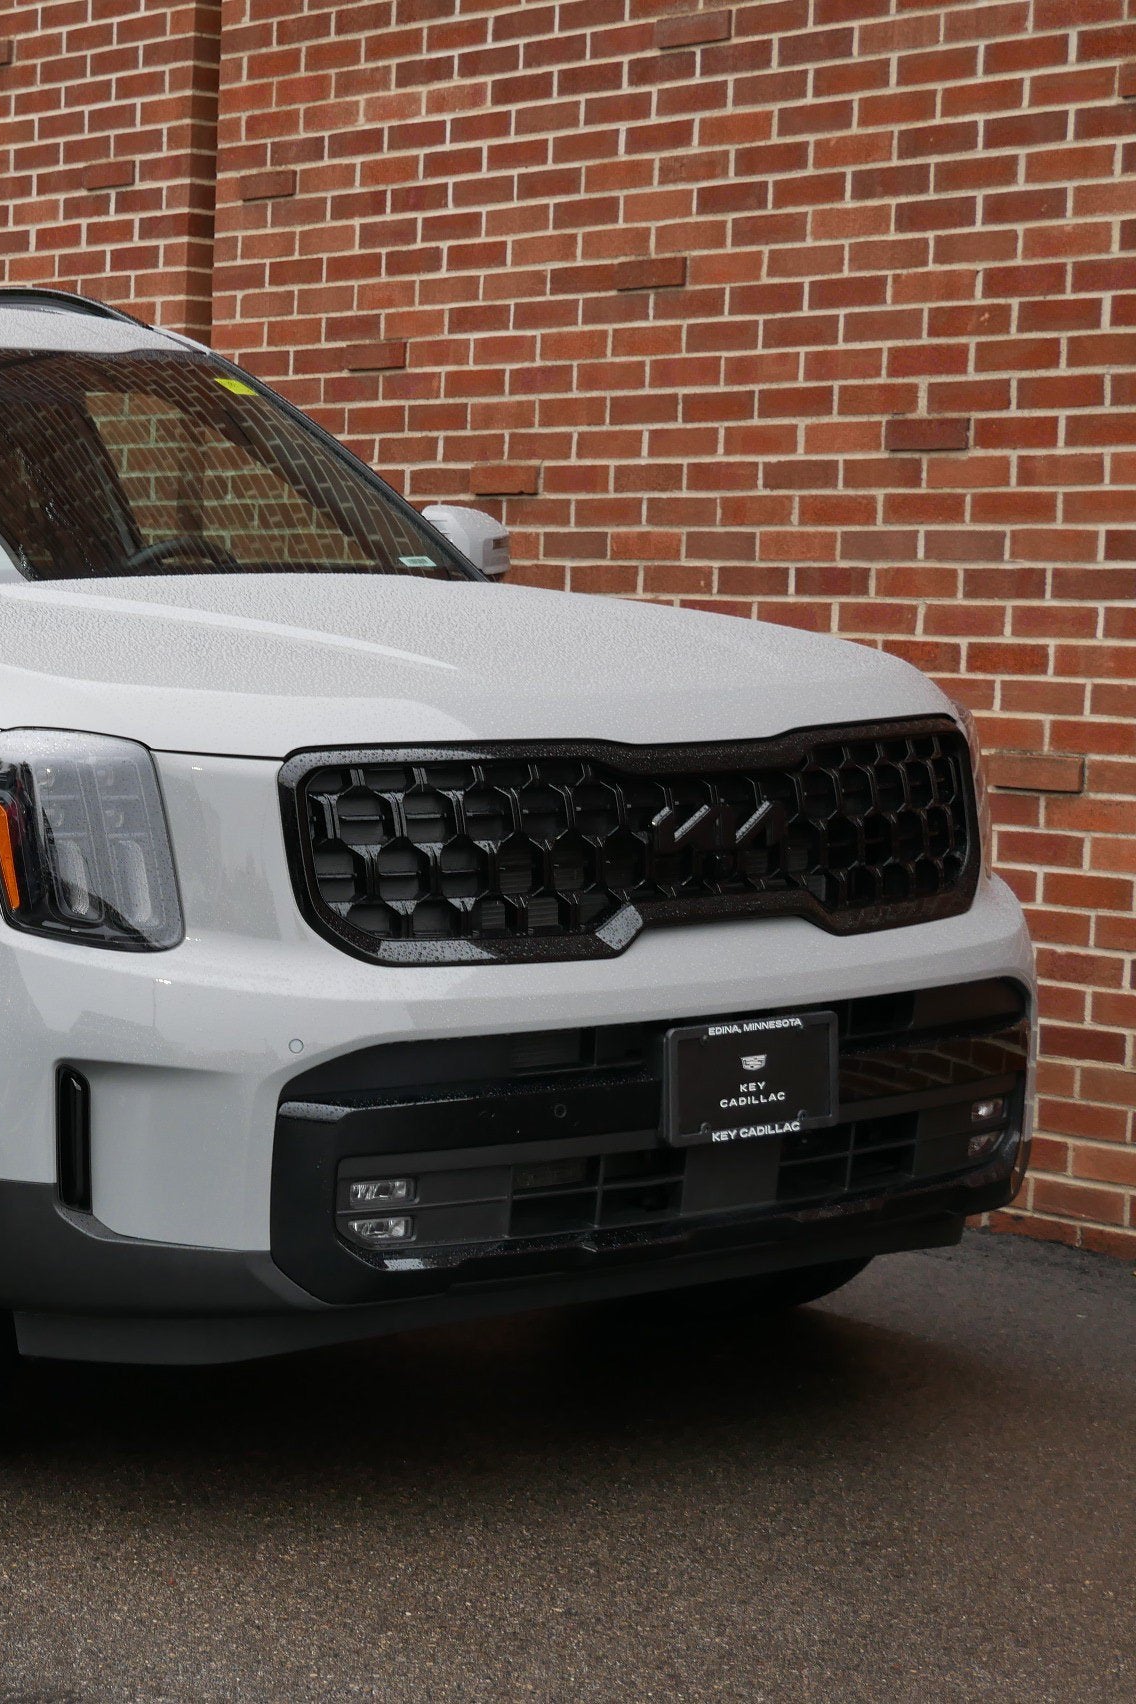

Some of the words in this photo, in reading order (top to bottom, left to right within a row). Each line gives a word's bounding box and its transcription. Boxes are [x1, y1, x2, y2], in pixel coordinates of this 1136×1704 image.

[708, 1025, 741, 1036] EDINA,
[743, 1018, 802, 1032] MINNESOTA
[739, 1081, 766, 1092] KEY
[719, 1091, 786, 1108] CADILLAC
[712, 1129, 738, 1142] KEY
[740, 1121, 801, 1138] CADILLAC
